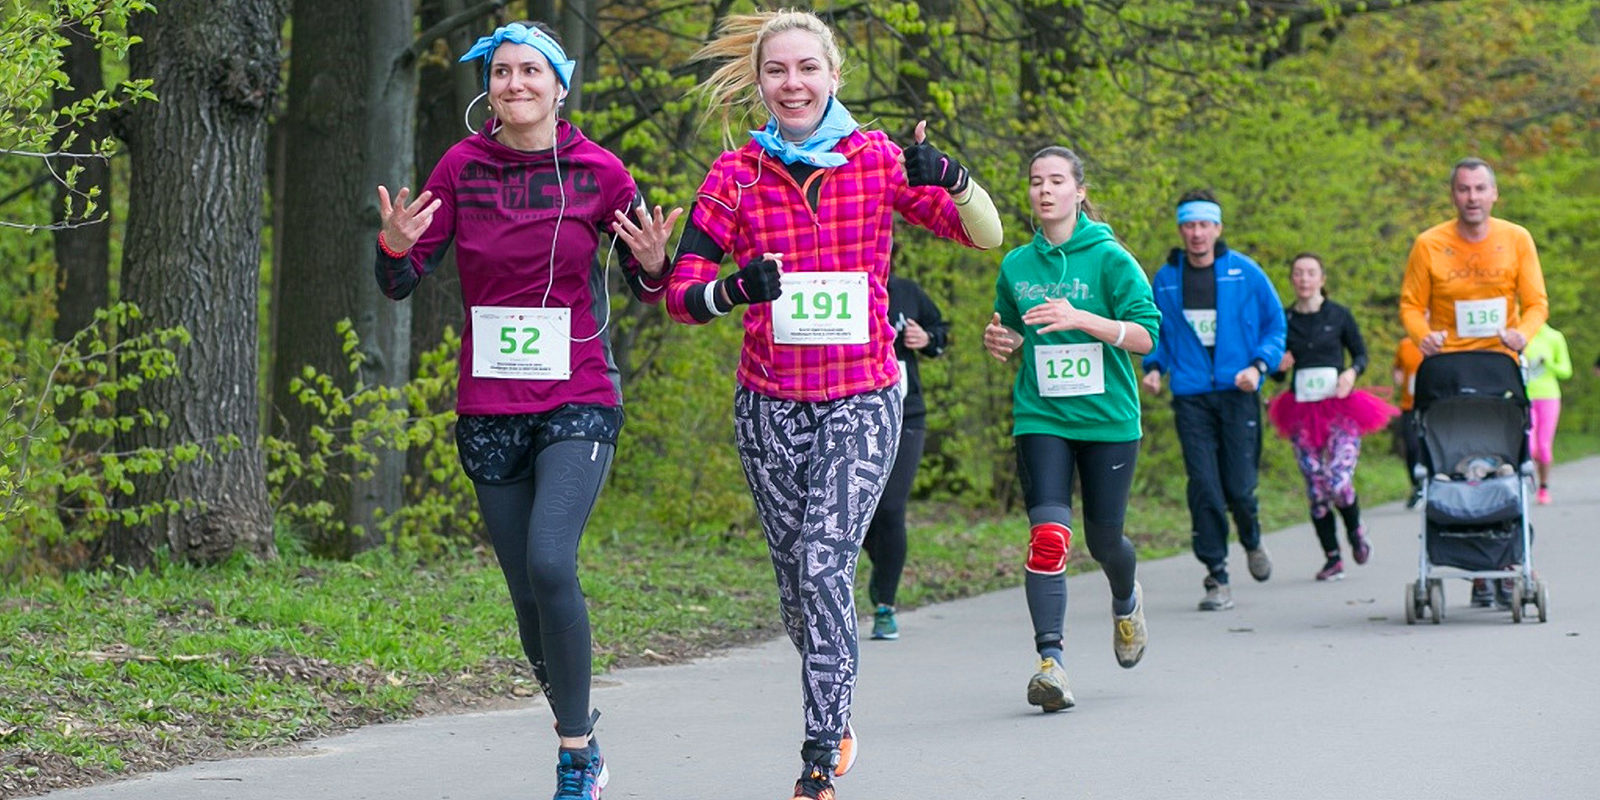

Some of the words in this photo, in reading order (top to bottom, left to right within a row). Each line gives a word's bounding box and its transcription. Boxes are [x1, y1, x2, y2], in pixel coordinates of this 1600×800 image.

[791, 292, 852, 320] 191
[1467, 309, 1499, 325] 136
[500, 327, 540, 354] 52
[1046, 357, 1091, 379] 120
[1306, 377, 1326, 389] 49
